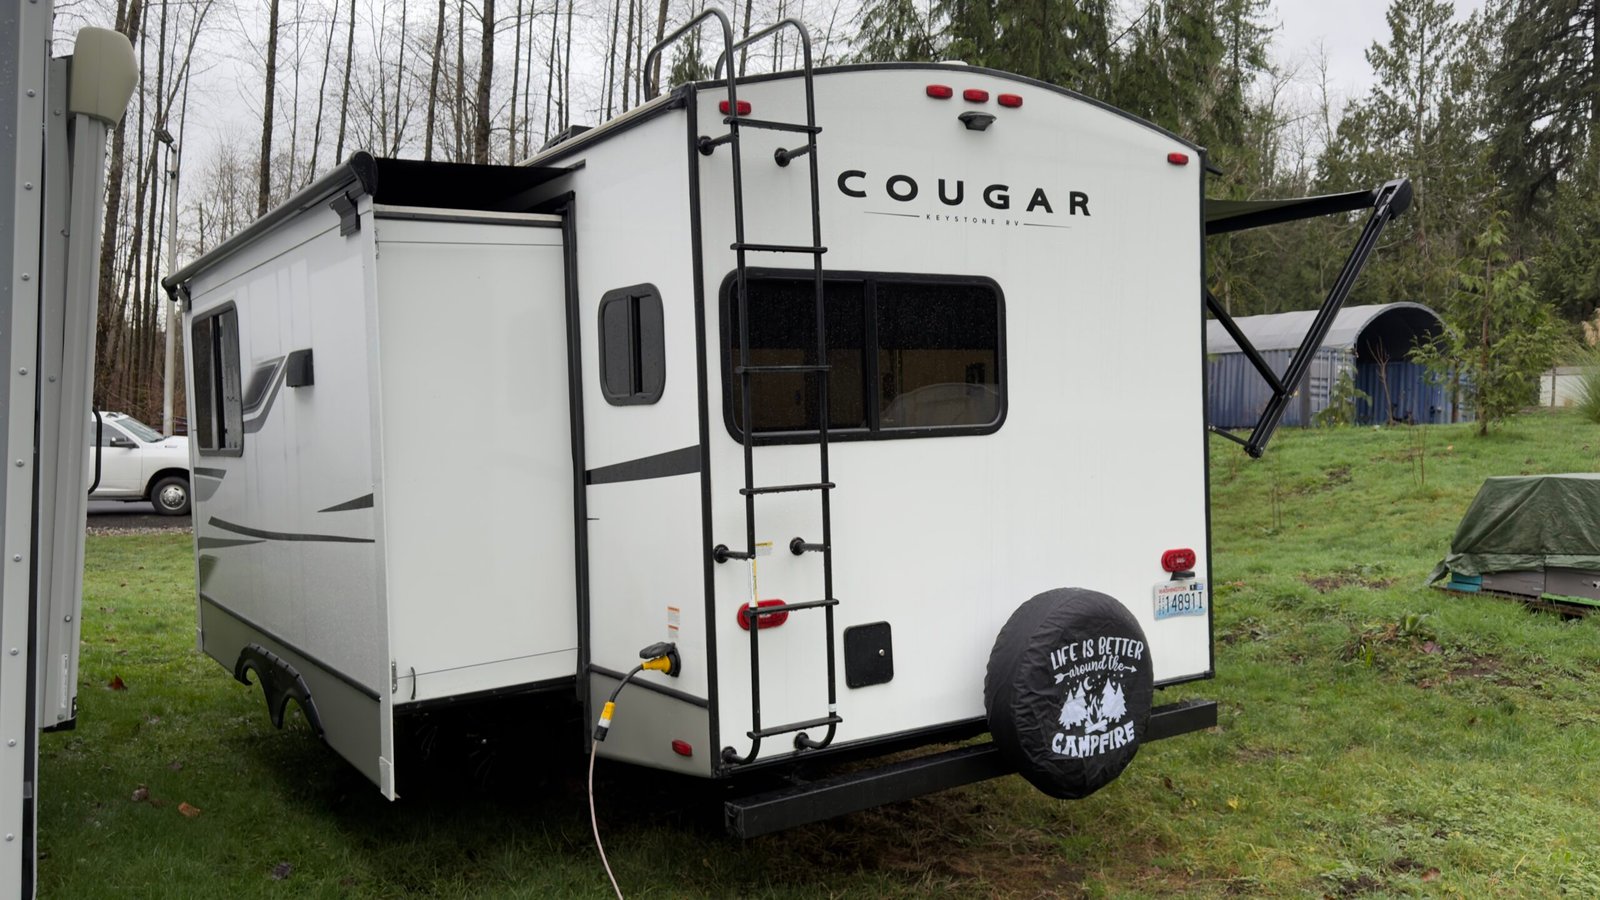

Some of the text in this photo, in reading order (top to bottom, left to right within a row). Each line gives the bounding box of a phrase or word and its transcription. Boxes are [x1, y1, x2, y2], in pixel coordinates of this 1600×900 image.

[837, 169, 1092, 217] COUGAR
[926, 214, 1020, 227] KEYSTONE RV
[1050, 636, 1144, 671] LIFE IS BETTER
[1069, 655, 1125, 678] around the
[1051, 720, 1135, 759] CAMPFIRE
